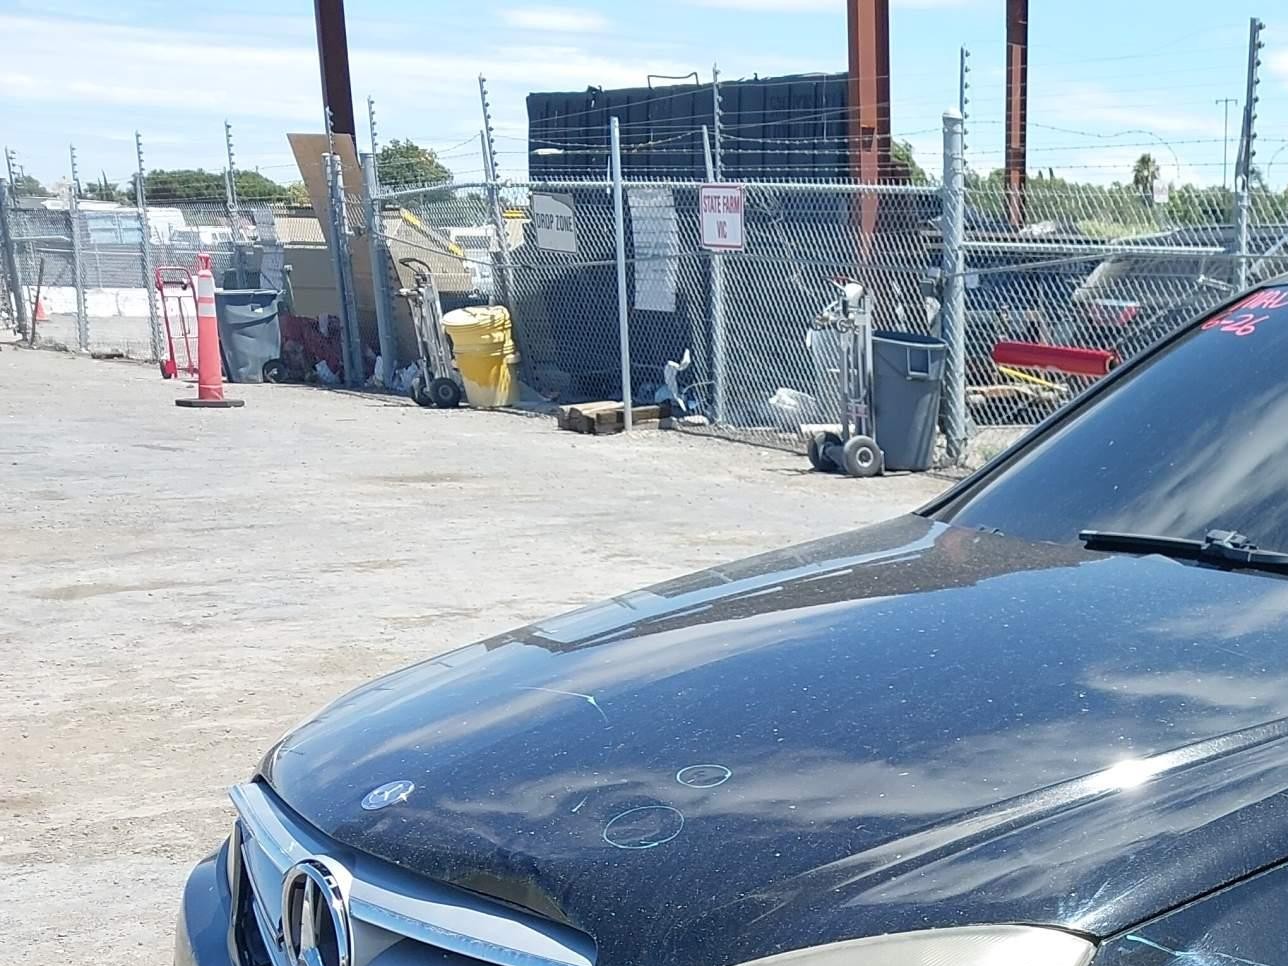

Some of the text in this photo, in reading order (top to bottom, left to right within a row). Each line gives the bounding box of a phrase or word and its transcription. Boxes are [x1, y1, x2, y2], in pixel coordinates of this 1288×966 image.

[703, 194, 740, 213] STATE FARM
[535, 213, 574, 232] DROP ZONE
